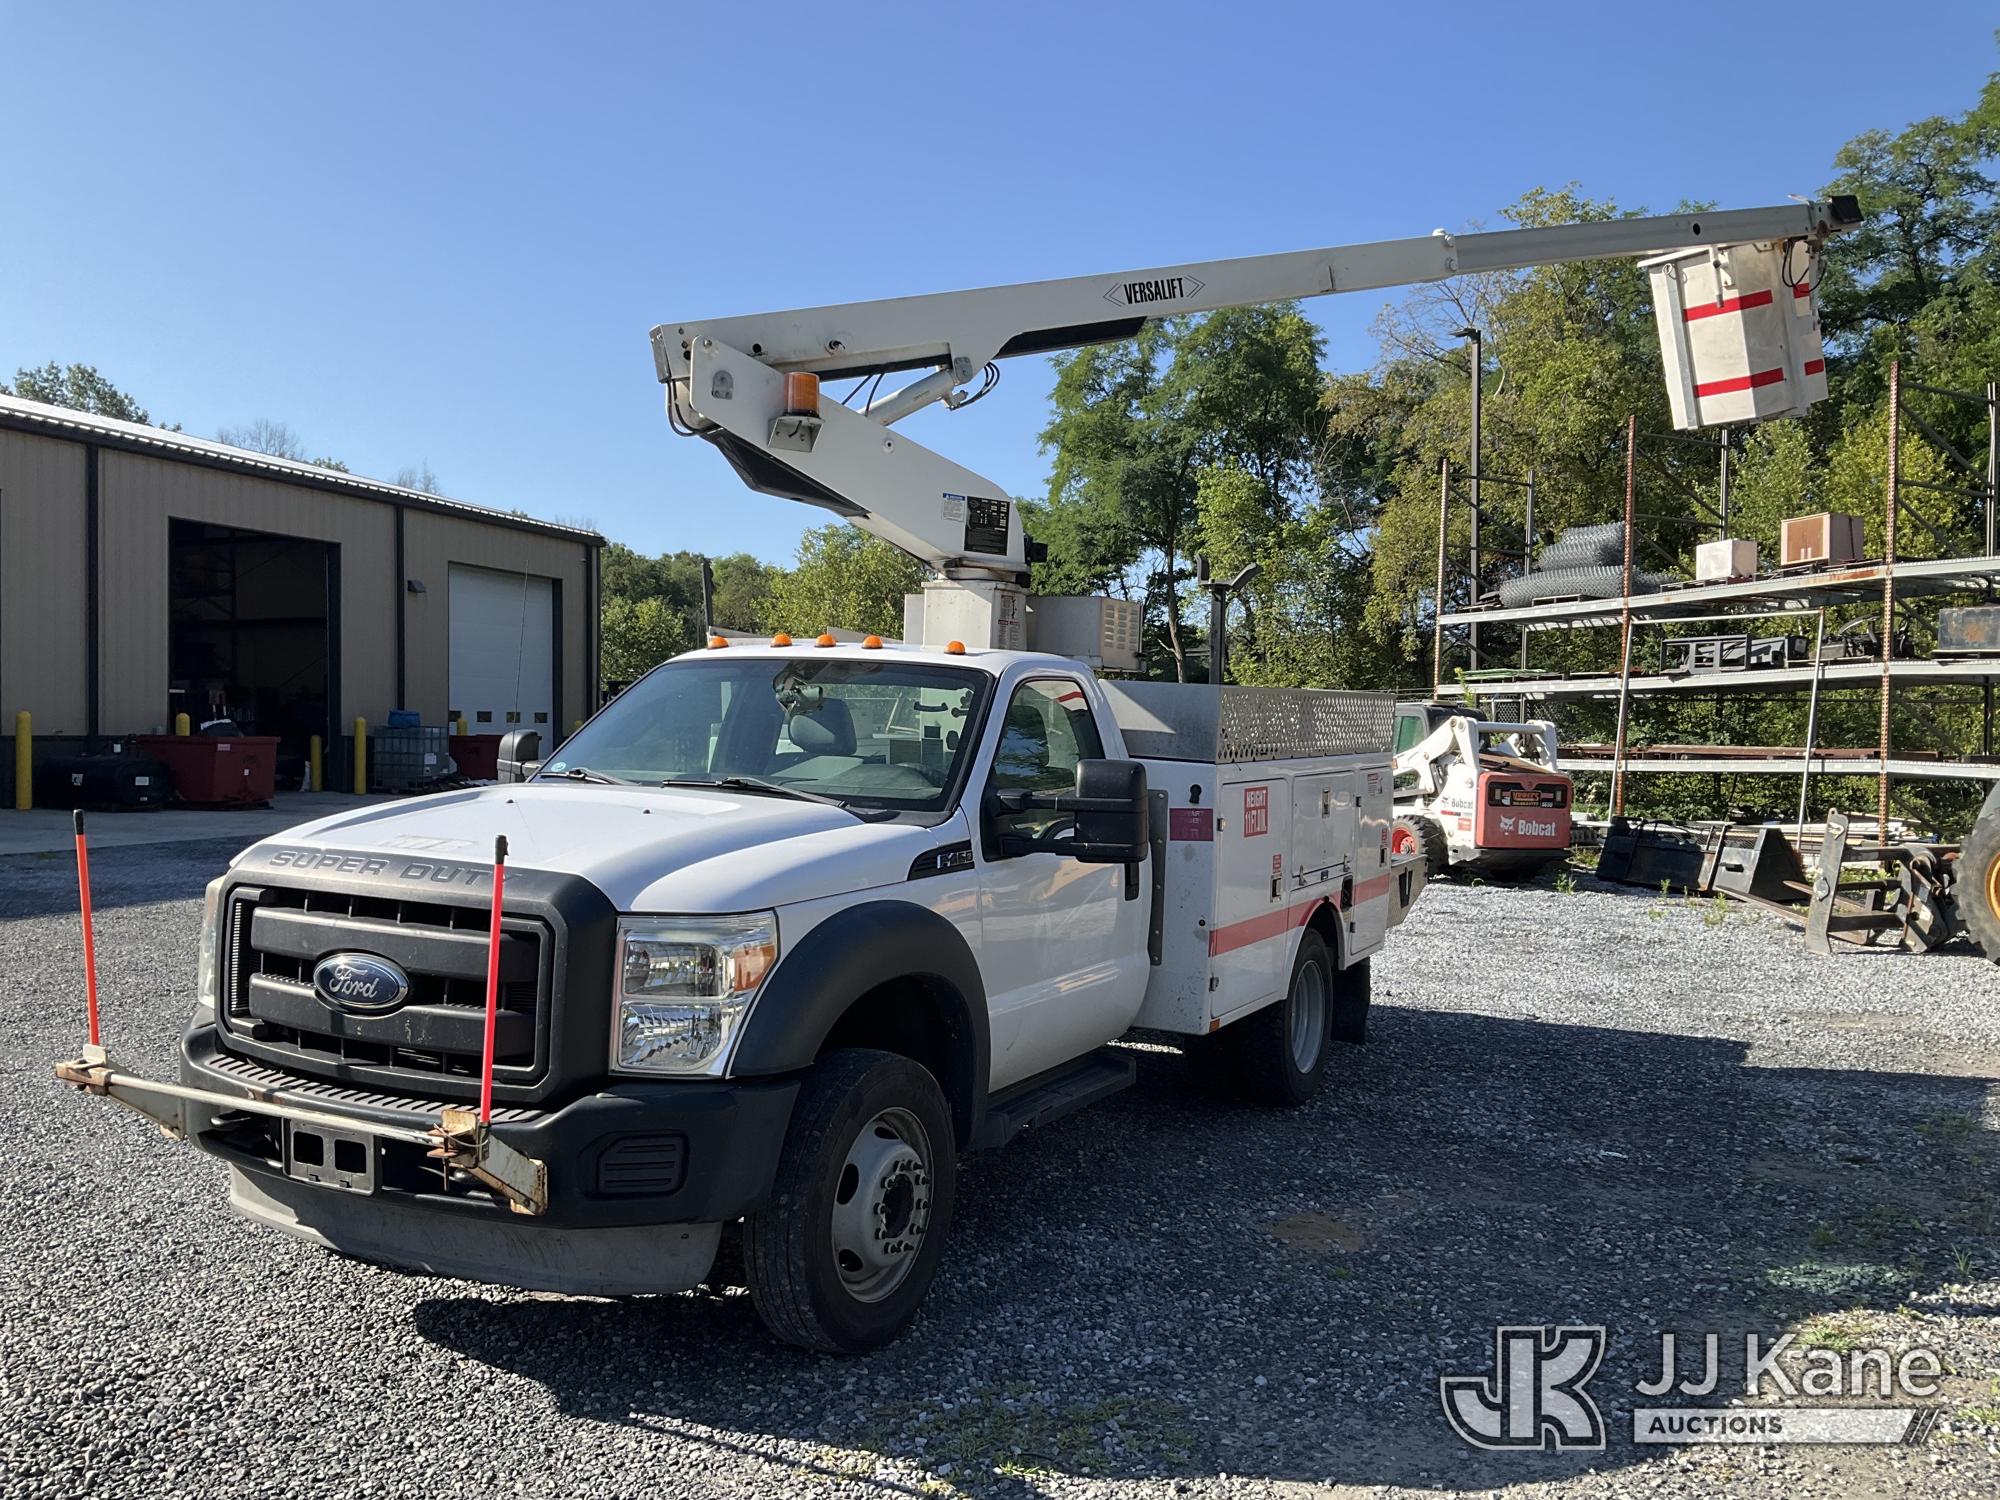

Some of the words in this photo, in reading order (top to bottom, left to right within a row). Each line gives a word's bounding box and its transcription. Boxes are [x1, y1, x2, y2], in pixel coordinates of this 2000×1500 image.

[1123, 277, 1184, 305] VERSALIFT
[1451, 798, 1474, 809] Bobcat
[1518, 819, 1556, 836] Bobcat
[269, 850, 390, 876] SUPER
[328, 963, 380, 998] Ford
